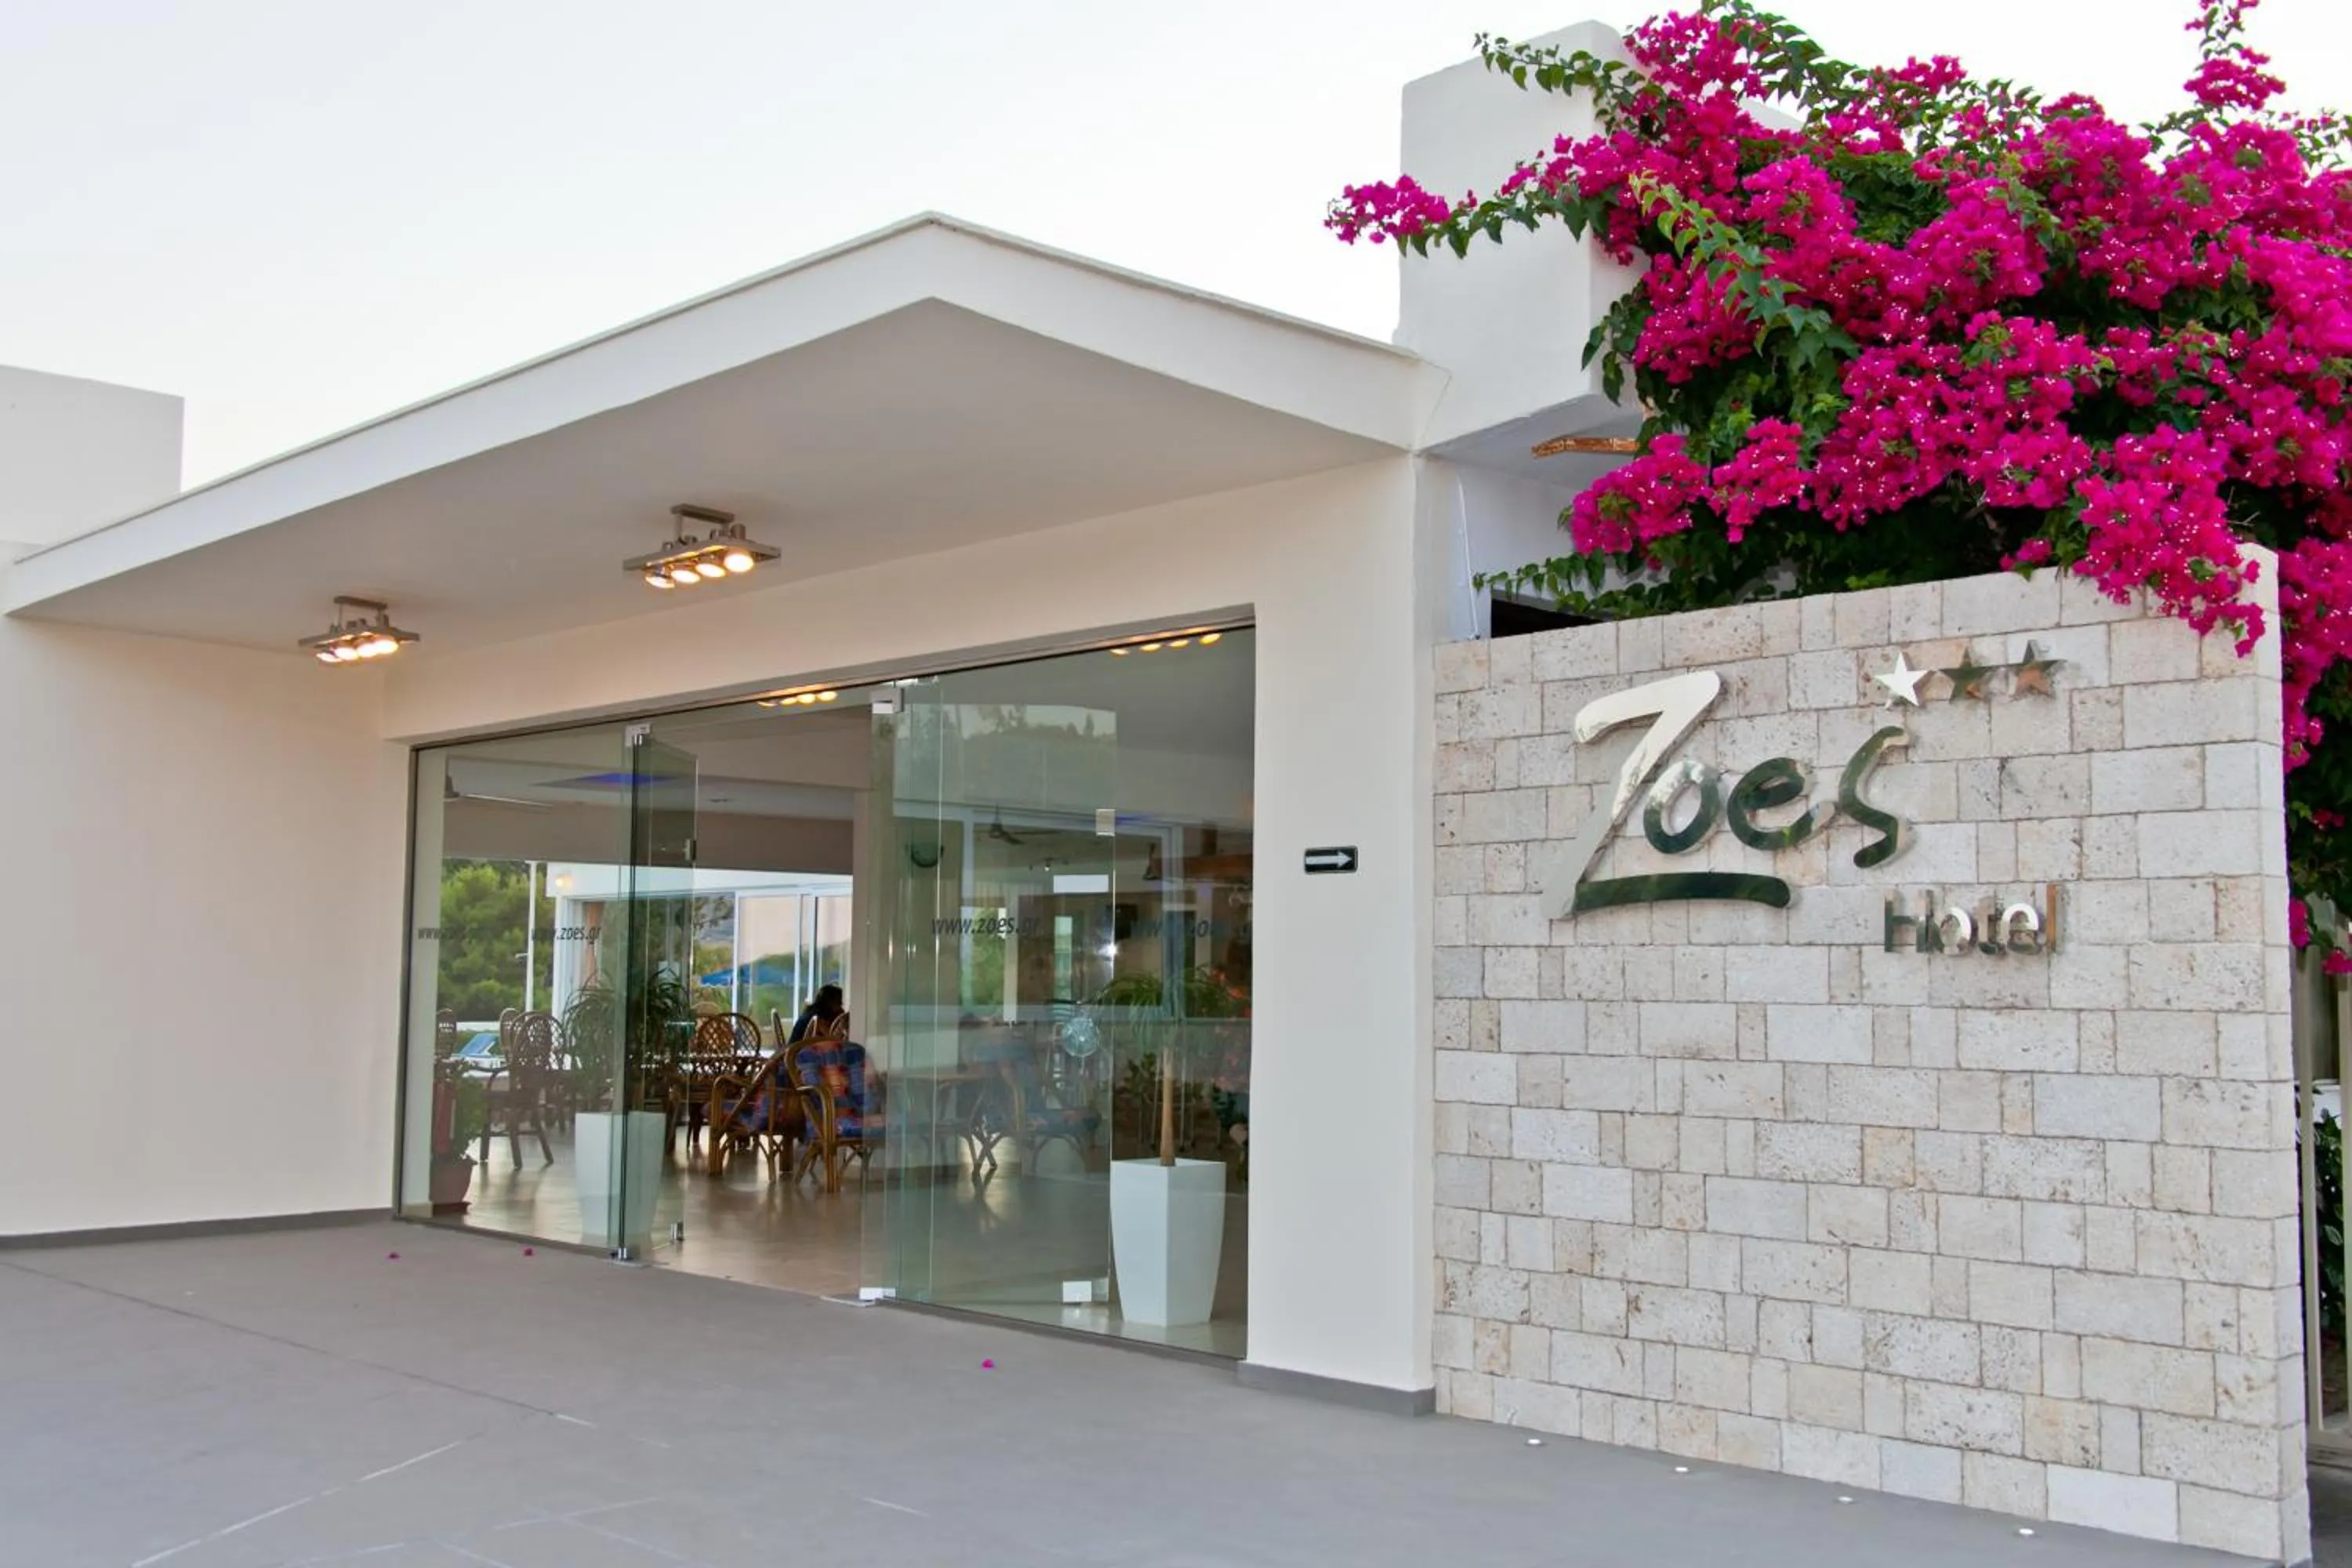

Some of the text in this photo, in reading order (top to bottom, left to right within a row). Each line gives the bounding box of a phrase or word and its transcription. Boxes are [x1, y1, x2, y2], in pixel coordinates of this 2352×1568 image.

[1541, 670, 1907, 919] Zoes
[531, 926, 602, 945] w.zoes.gr
[931, 916, 1041, 938] www.zoes.gr
[1883, 884, 2061, 955] Hotel
